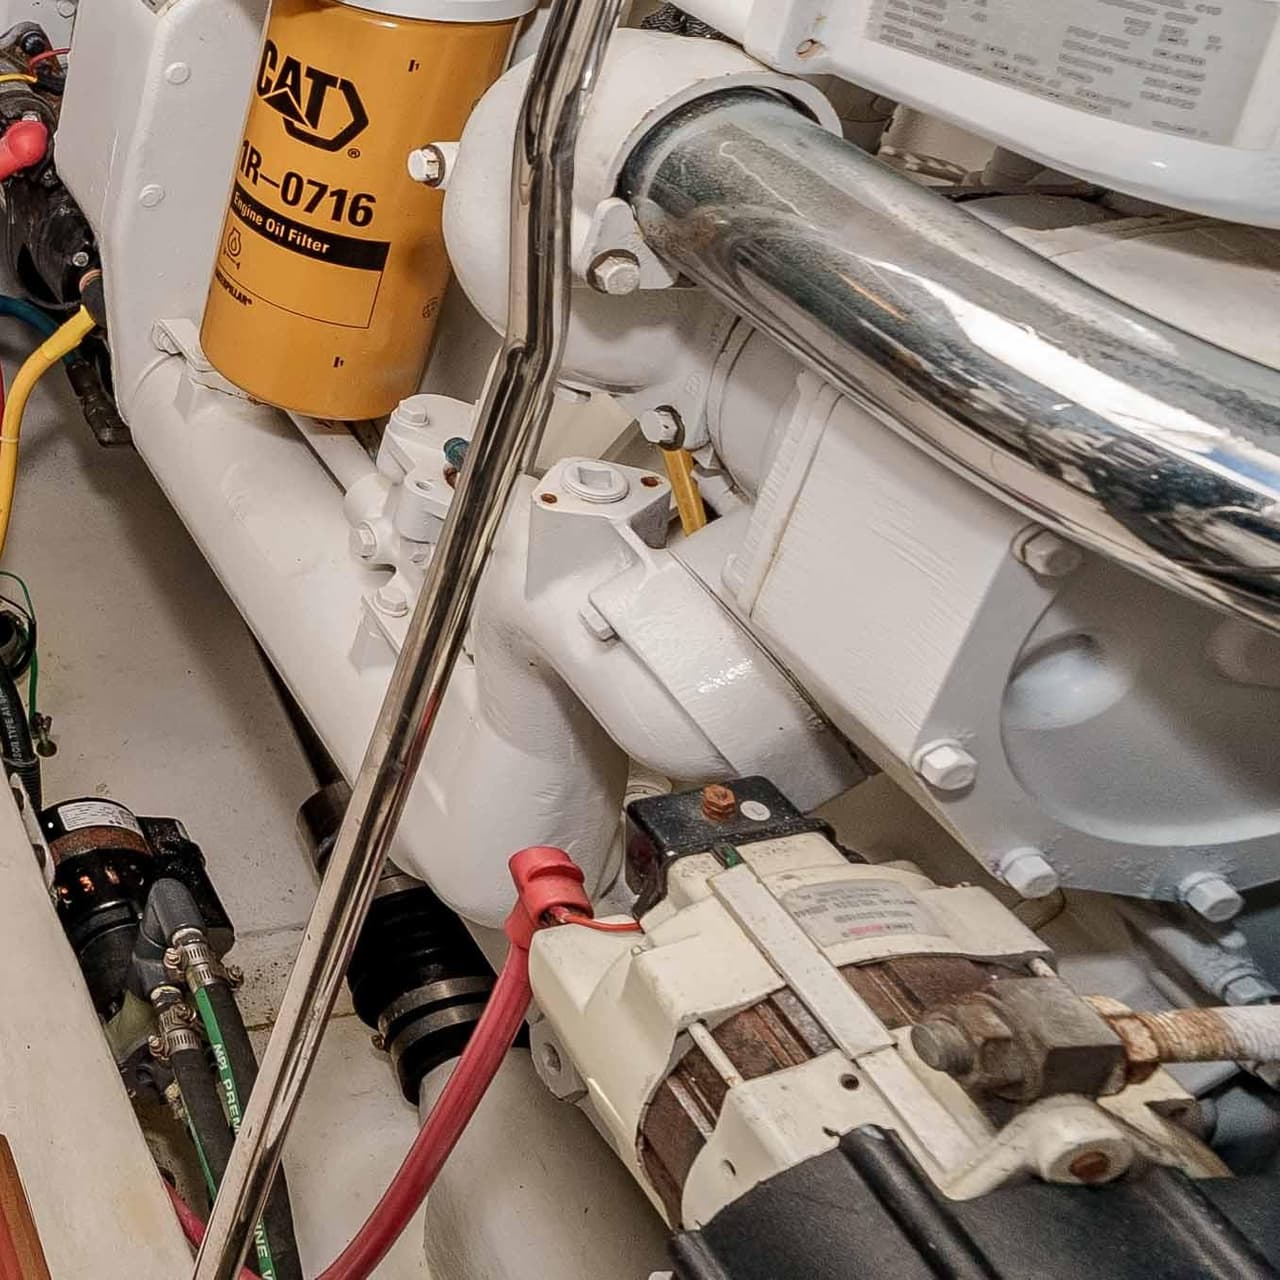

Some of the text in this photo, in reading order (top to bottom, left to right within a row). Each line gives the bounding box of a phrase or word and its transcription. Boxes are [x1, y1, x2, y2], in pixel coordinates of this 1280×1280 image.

[257, 40, 340, 130] CAT
[240, 139, 377, 228] 1R-0716
[233, 191, 330, 254] Engine Oil Filter
[4, 718, 18, 739] TYPE
[212, 1042, 229, 1071] MPI
